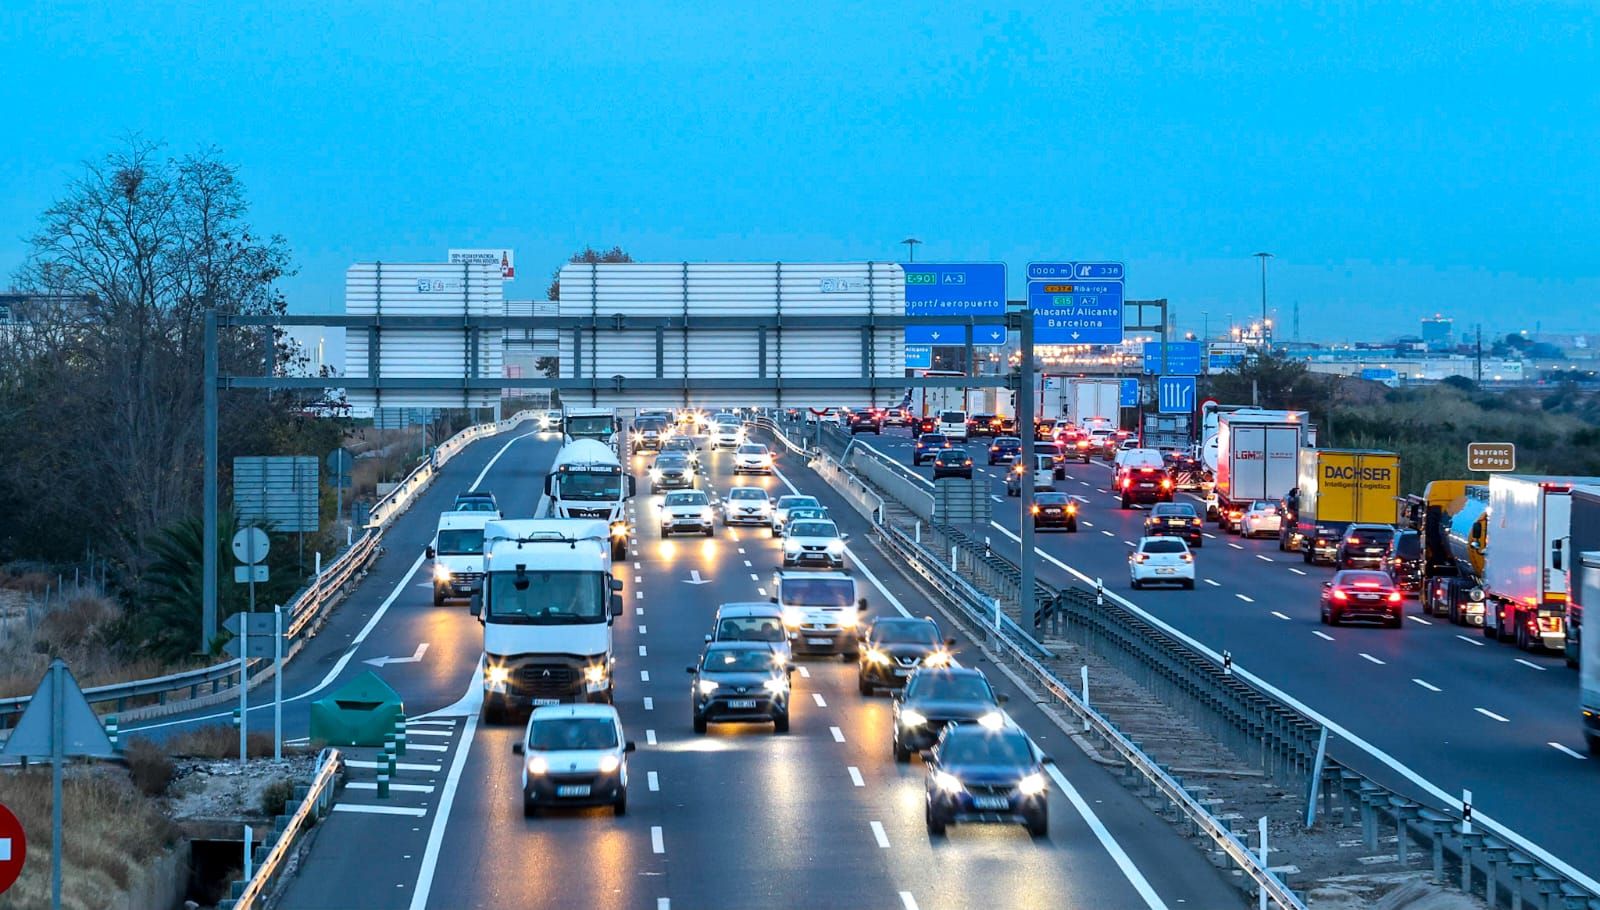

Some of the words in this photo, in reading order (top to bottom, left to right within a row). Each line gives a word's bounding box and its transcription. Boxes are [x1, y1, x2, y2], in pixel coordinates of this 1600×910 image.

[907, 274, 935, 283] E-901
[944, 274, 964, 283] A-3
[940, 300, 999, 310] aeropuerto
[1054, 297, 1072, 305] E-15
[1081, 297, 1096, 305] A-7
[1076, 307, 1118, 316] Alicante
[1048, 319, 1103, 328] Barcelona
[1473, 448, 1509, 456] barranc
[1473, 457, 1484, 465] de
[1325, 465, 1391, 481] DACHSER
